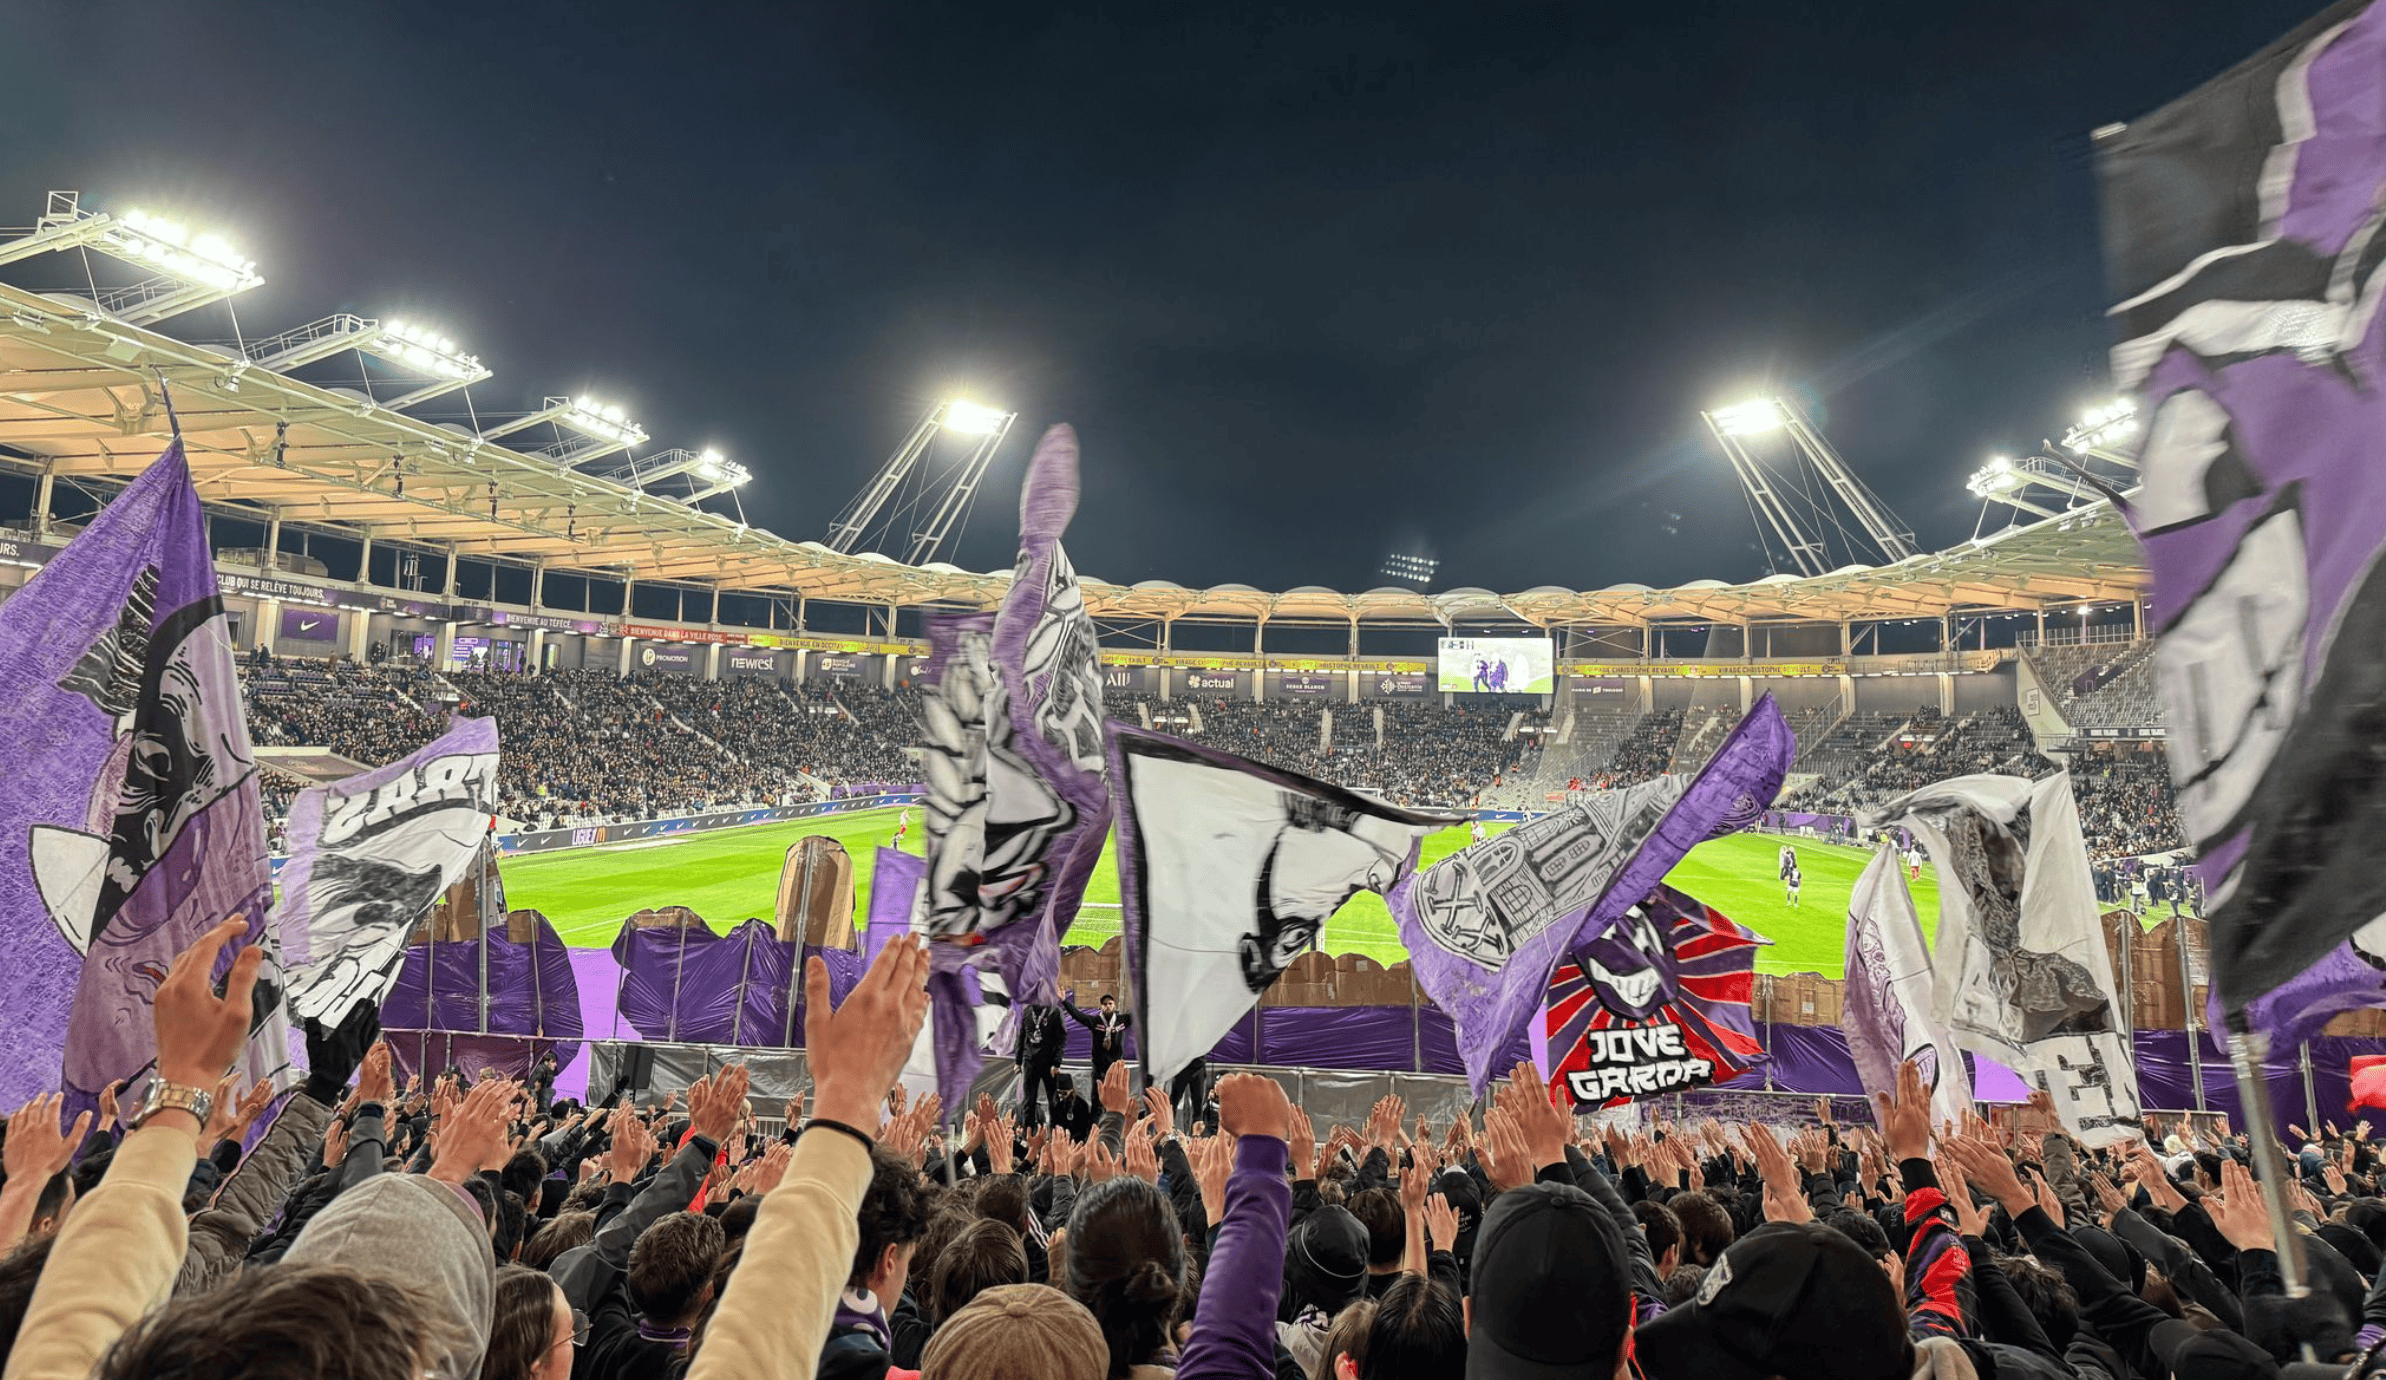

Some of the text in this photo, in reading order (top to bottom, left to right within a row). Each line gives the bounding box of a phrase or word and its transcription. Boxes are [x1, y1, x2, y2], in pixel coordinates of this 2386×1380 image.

[217, 574, 324, 599] CLUB QUI SE RELÈVE TOUJOURS.
[507, 613, 539, 625] BIENVENUE
[540, 617, 548, 626] AU
[630, 627, 663, 637] BIENVENUE
[681, 630, 688, 639] LA
[690, 631, 707, 640] VILLE
[1201, 677, 1234, 688] actual
[1589, 1023, 1686, 1064] JOVE
[1567, 1057, 1714, 1100] GARDA
